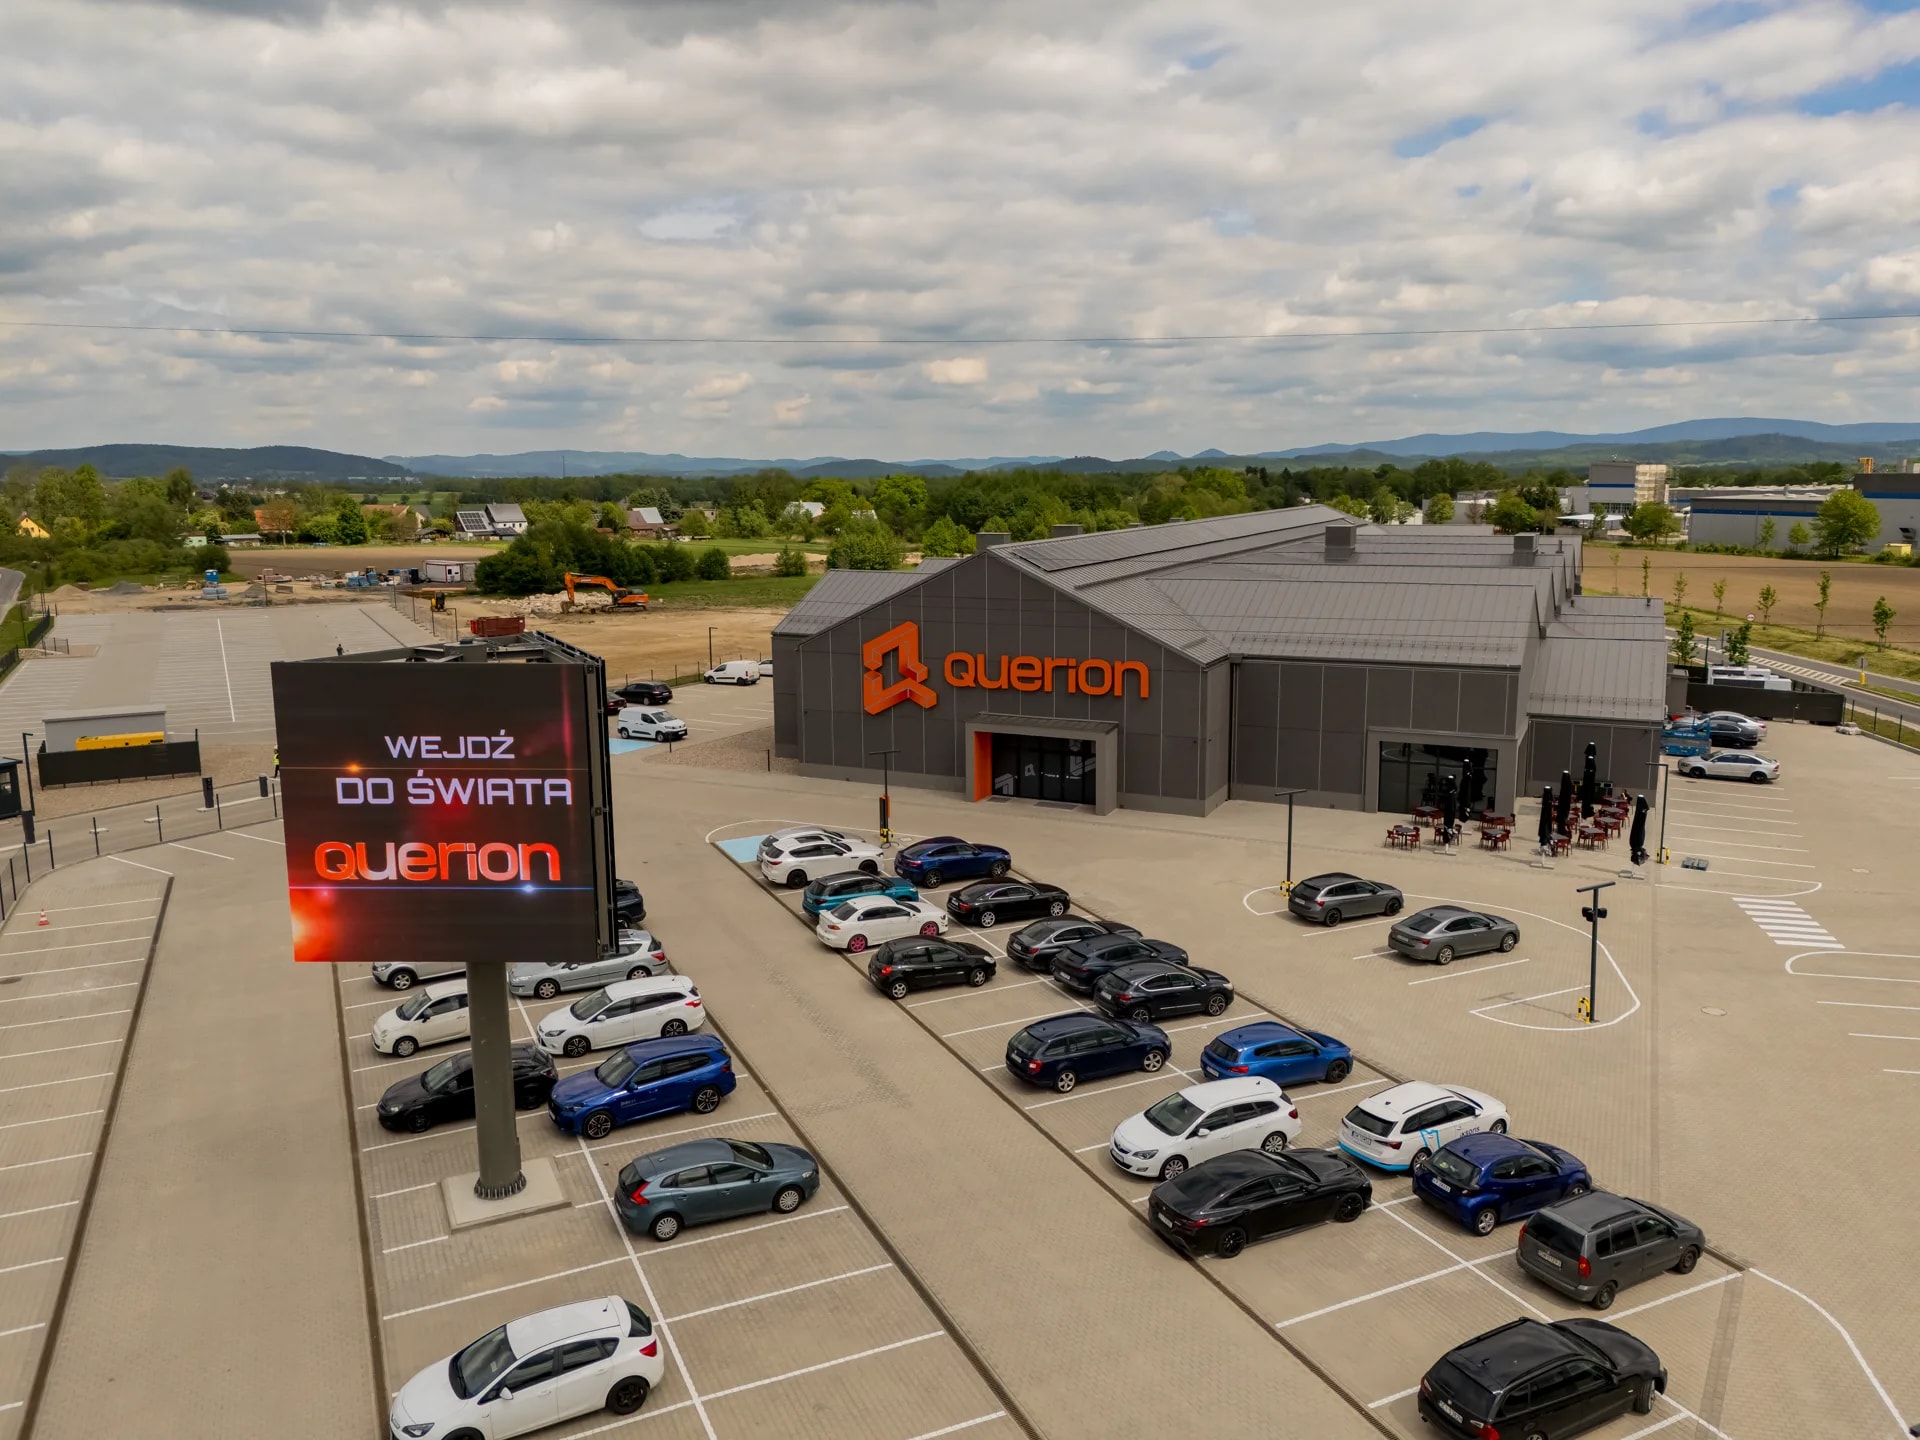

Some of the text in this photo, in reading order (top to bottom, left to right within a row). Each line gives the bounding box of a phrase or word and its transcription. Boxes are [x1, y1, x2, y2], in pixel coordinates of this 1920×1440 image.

[944, 652, 1149, 698] Querion
[384, 729, 515, 759] WEJDŹ
[336, 769, 572, 805] DO ŚWIATA
[314, 841, 561, 881] Querion
